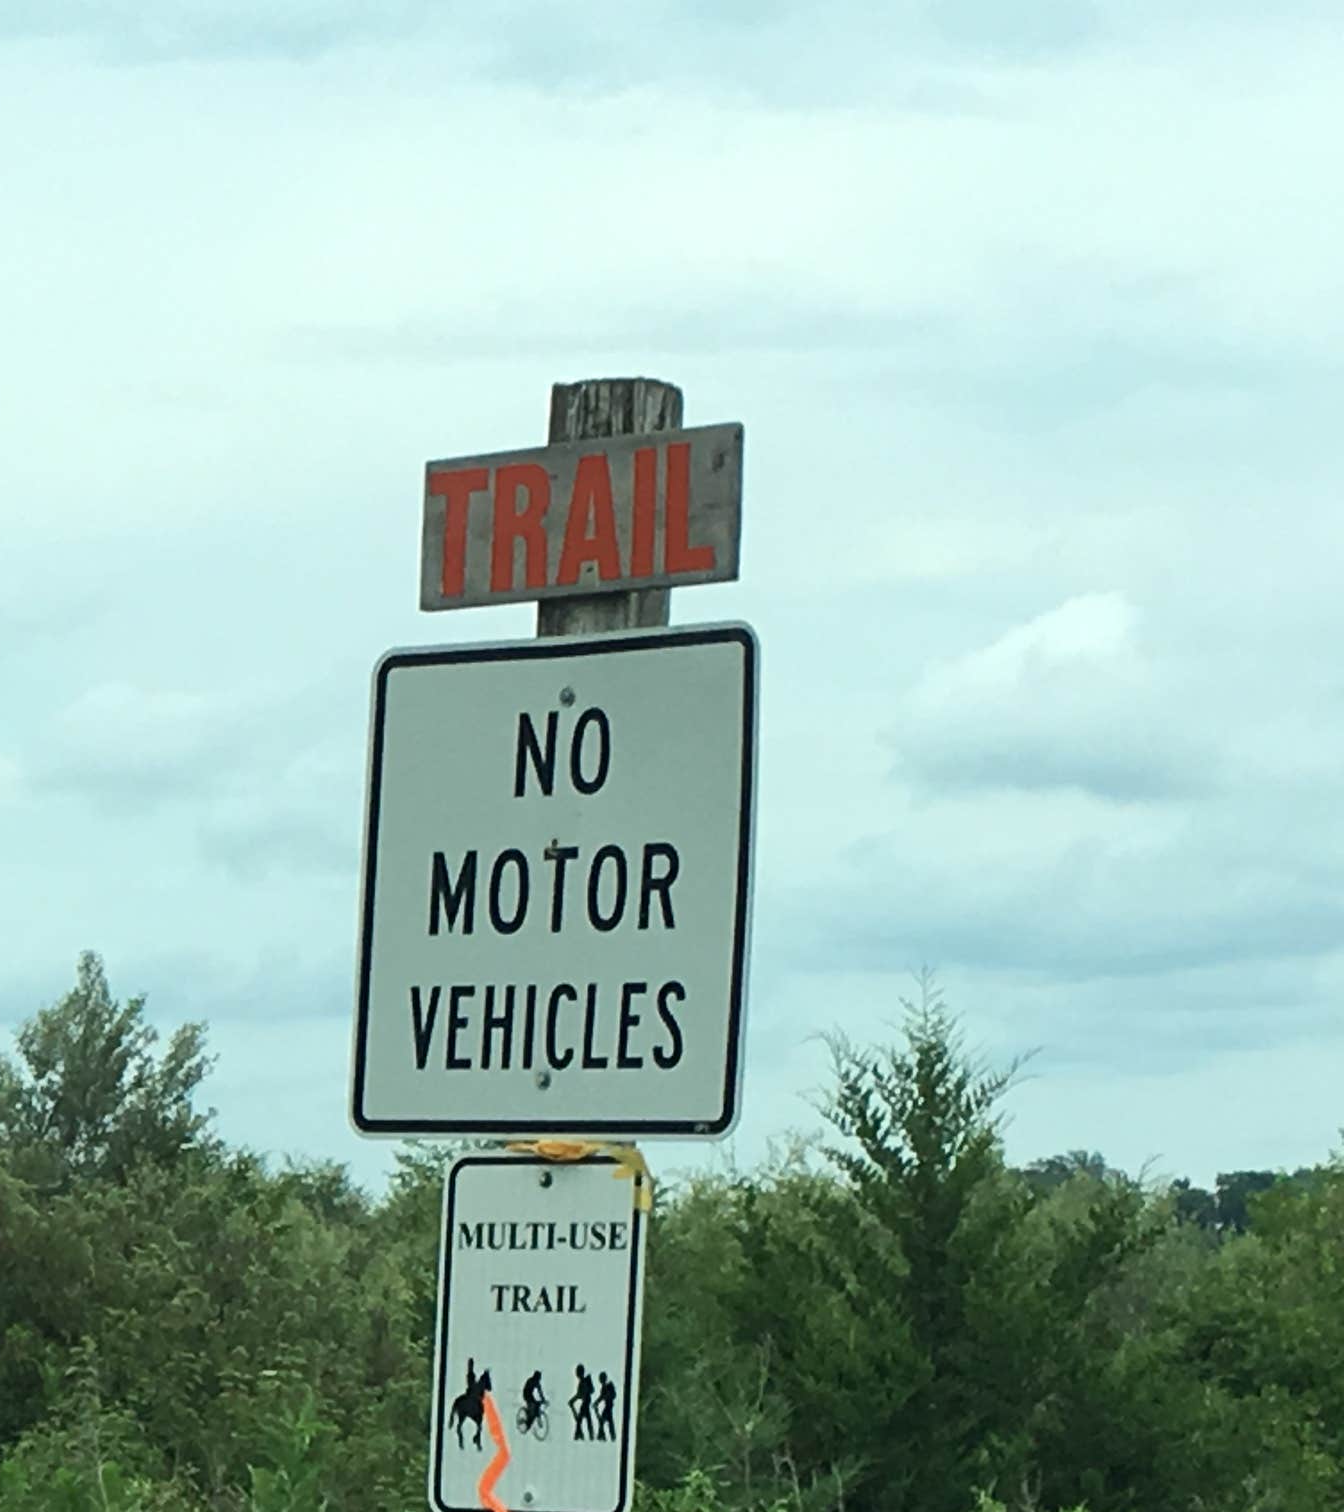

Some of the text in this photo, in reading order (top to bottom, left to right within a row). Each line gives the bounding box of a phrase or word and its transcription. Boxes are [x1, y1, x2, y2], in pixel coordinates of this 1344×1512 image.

[428, 442, 716, 598] TRAIL
[514, 707, 611, 797] NO
[429, 842, 680, 936] MOTOR
[411, 981, 687, 1071] VEHICLES
[458, 1221, 628, 1251] MULTI-USE
[490, 1284, 587, 1314] TRAIL
